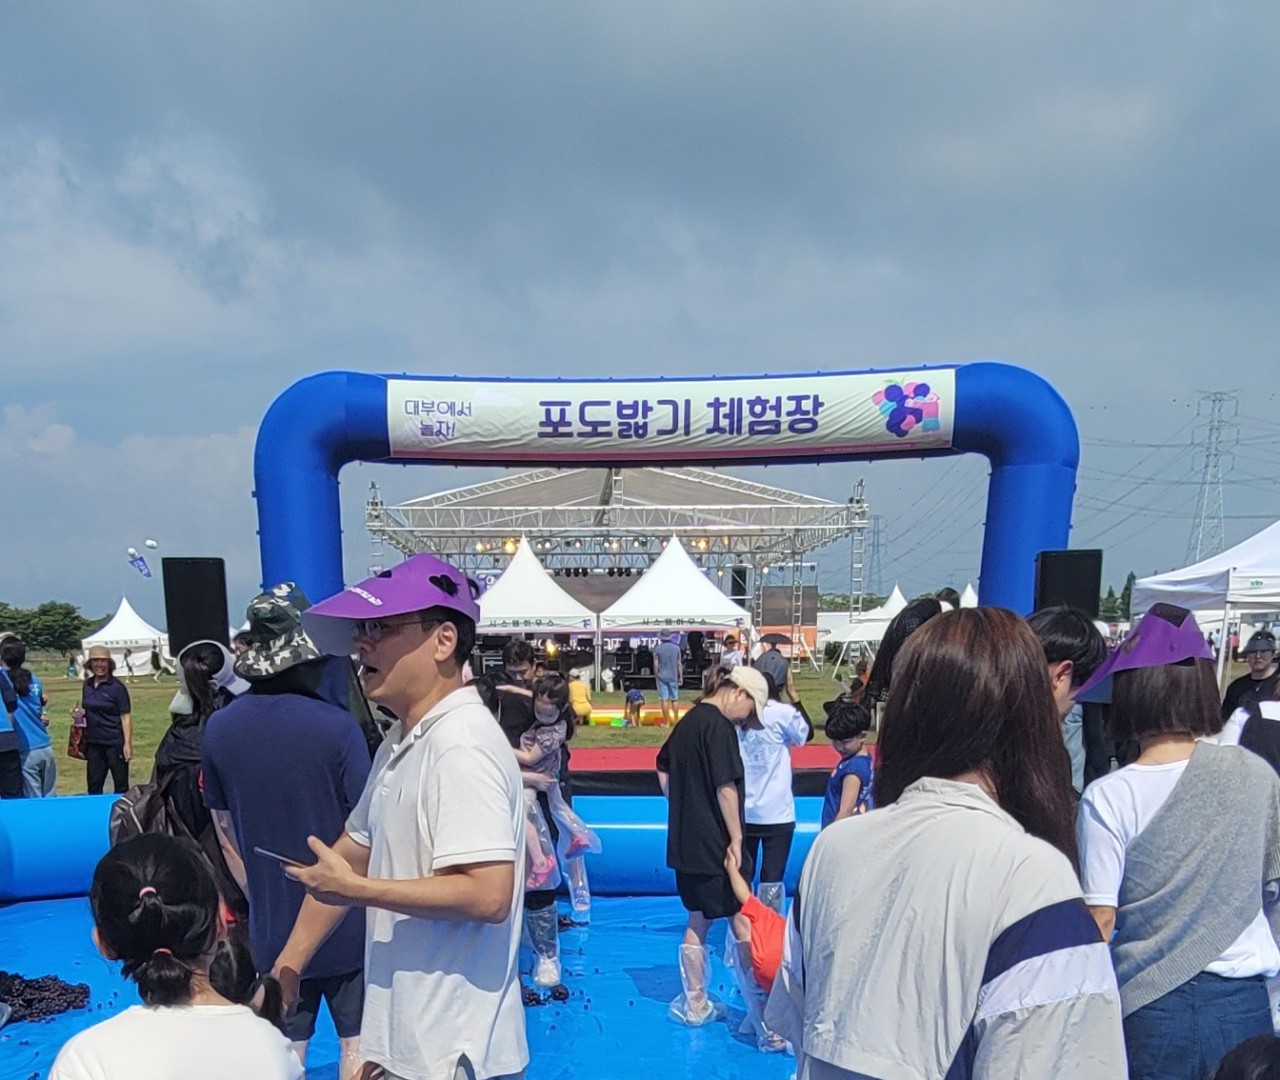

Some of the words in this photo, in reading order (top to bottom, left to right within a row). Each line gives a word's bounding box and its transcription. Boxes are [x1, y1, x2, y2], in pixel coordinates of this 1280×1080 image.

[404, 399, 472, 417] 대부에서
[537, 399, 692, 439] 포도밟기
[705, 394, 825, 436] 체험장
[419, 420, 456, 437] 놀자!
